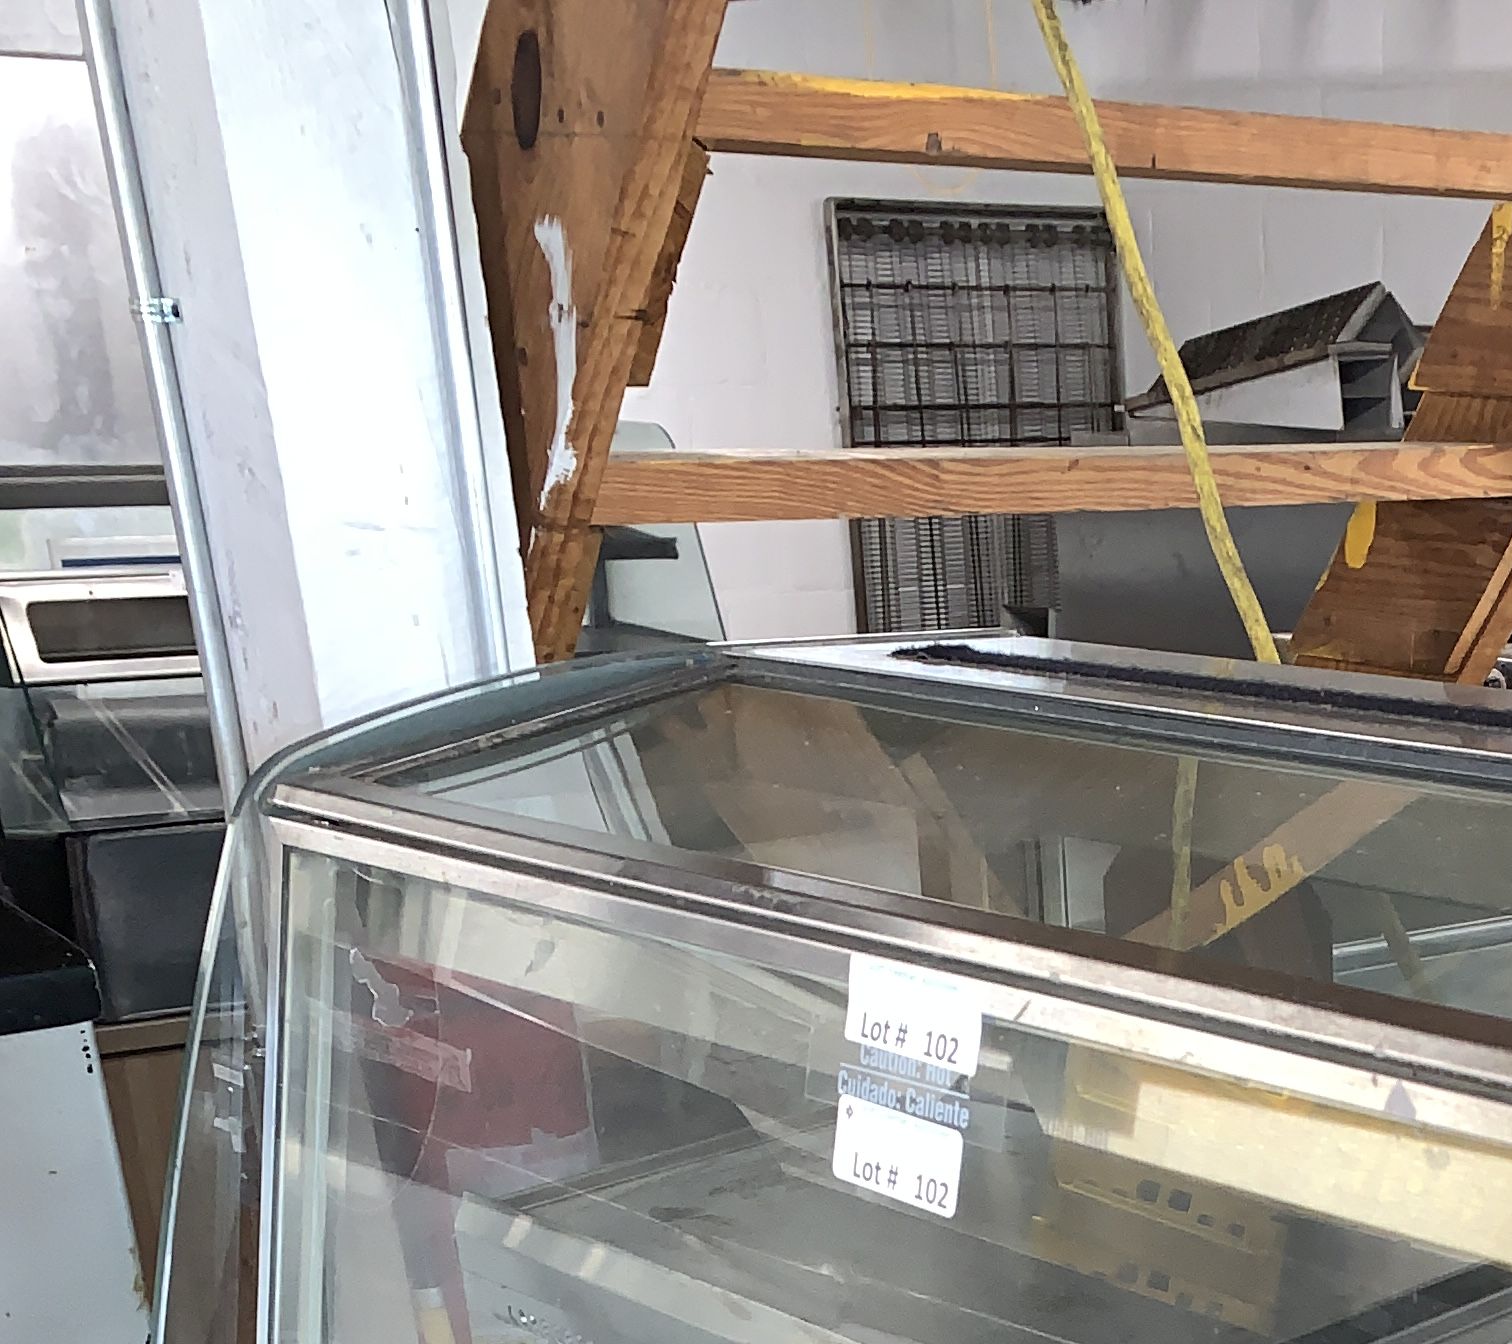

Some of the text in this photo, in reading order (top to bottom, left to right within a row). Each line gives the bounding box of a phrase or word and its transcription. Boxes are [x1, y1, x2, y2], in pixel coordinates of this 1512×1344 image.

[860, 1011, 959, 1066] Lot # 102
[837, 1069, 902, 1110] Cuidado:
[904, 1087, 970, 1130] Caliente
[852, 1151, 949, 1210] Lot # 102
